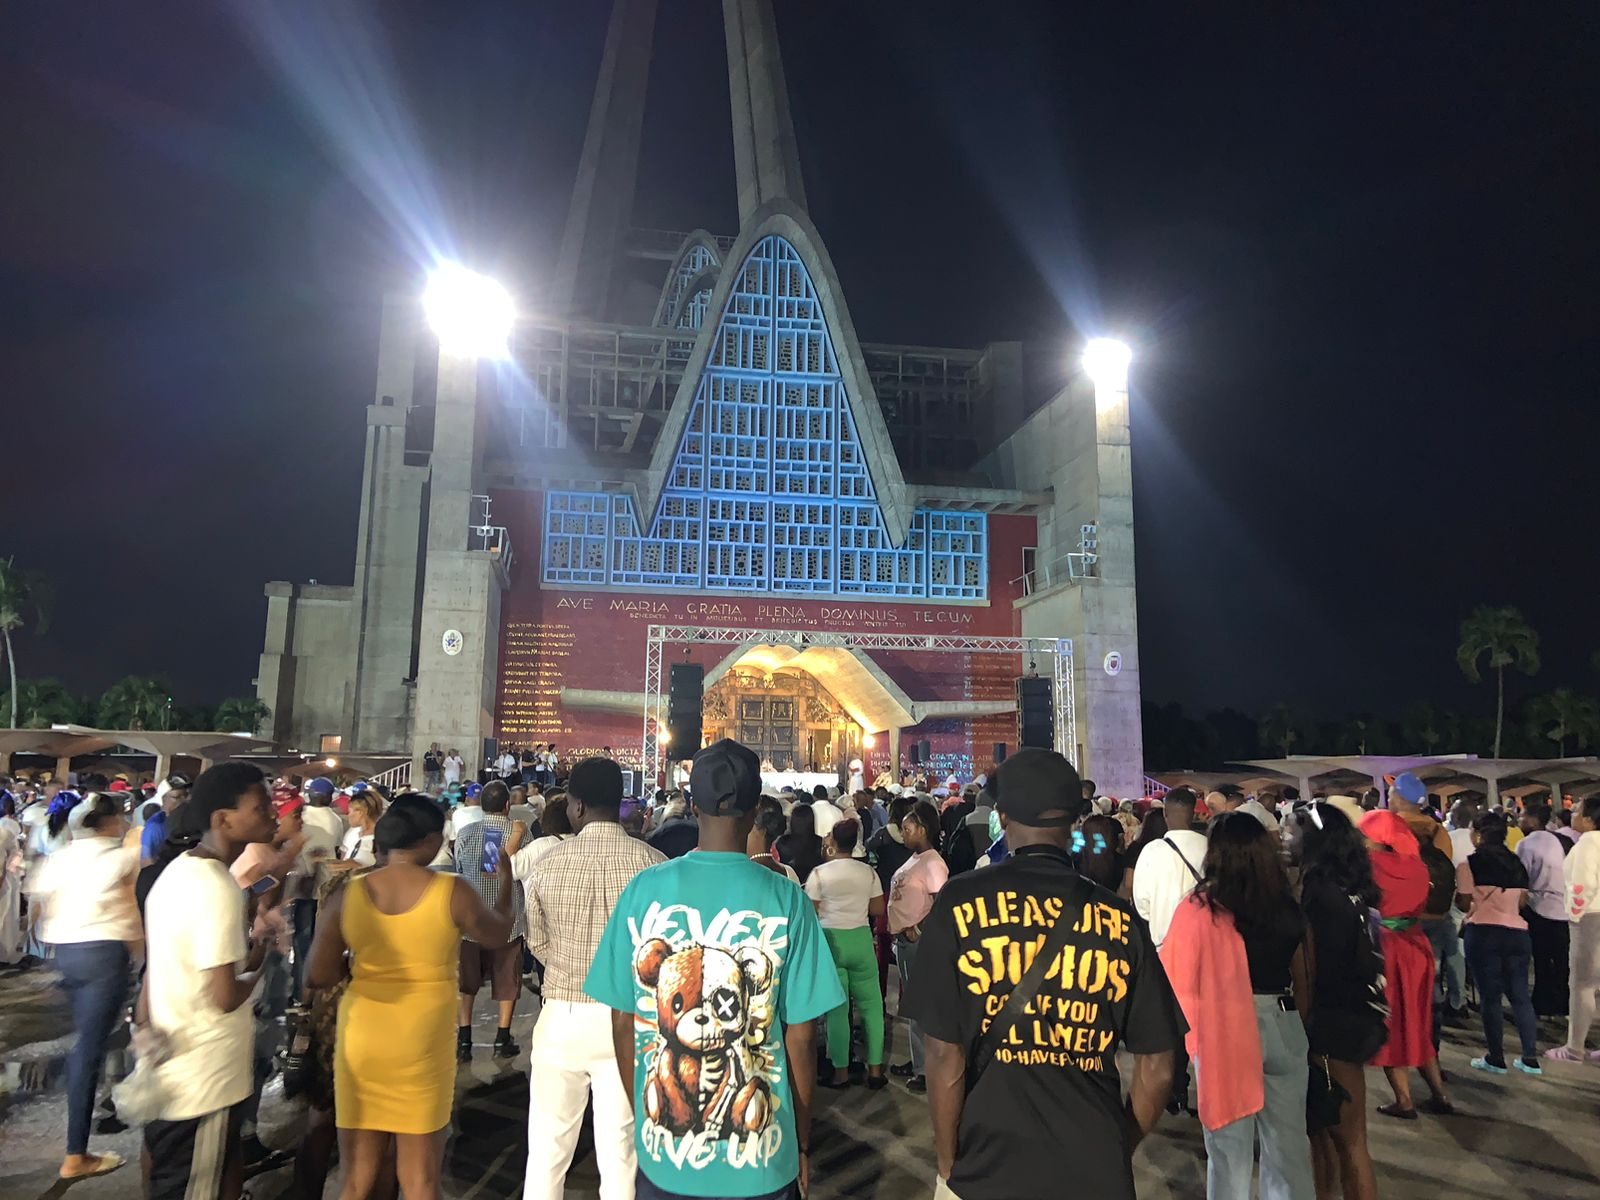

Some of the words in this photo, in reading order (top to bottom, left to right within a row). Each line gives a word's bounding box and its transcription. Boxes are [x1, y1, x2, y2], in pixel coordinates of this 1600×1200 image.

[556, 597, 594, 610] AVE
[609, 599, 670, 613] MARIA
[686, 602, 742, 616] GRATIA
[758, 605, 806, 618] PLENA
[820, 607, 898, 622] DOMINUS
[913, 610, 975, 624] TECUM
[1056, 998, 1099, 1024] YOU
[641, 1117, 720, 1171] GIVE
[727, 1122, 782, 1170] UP
